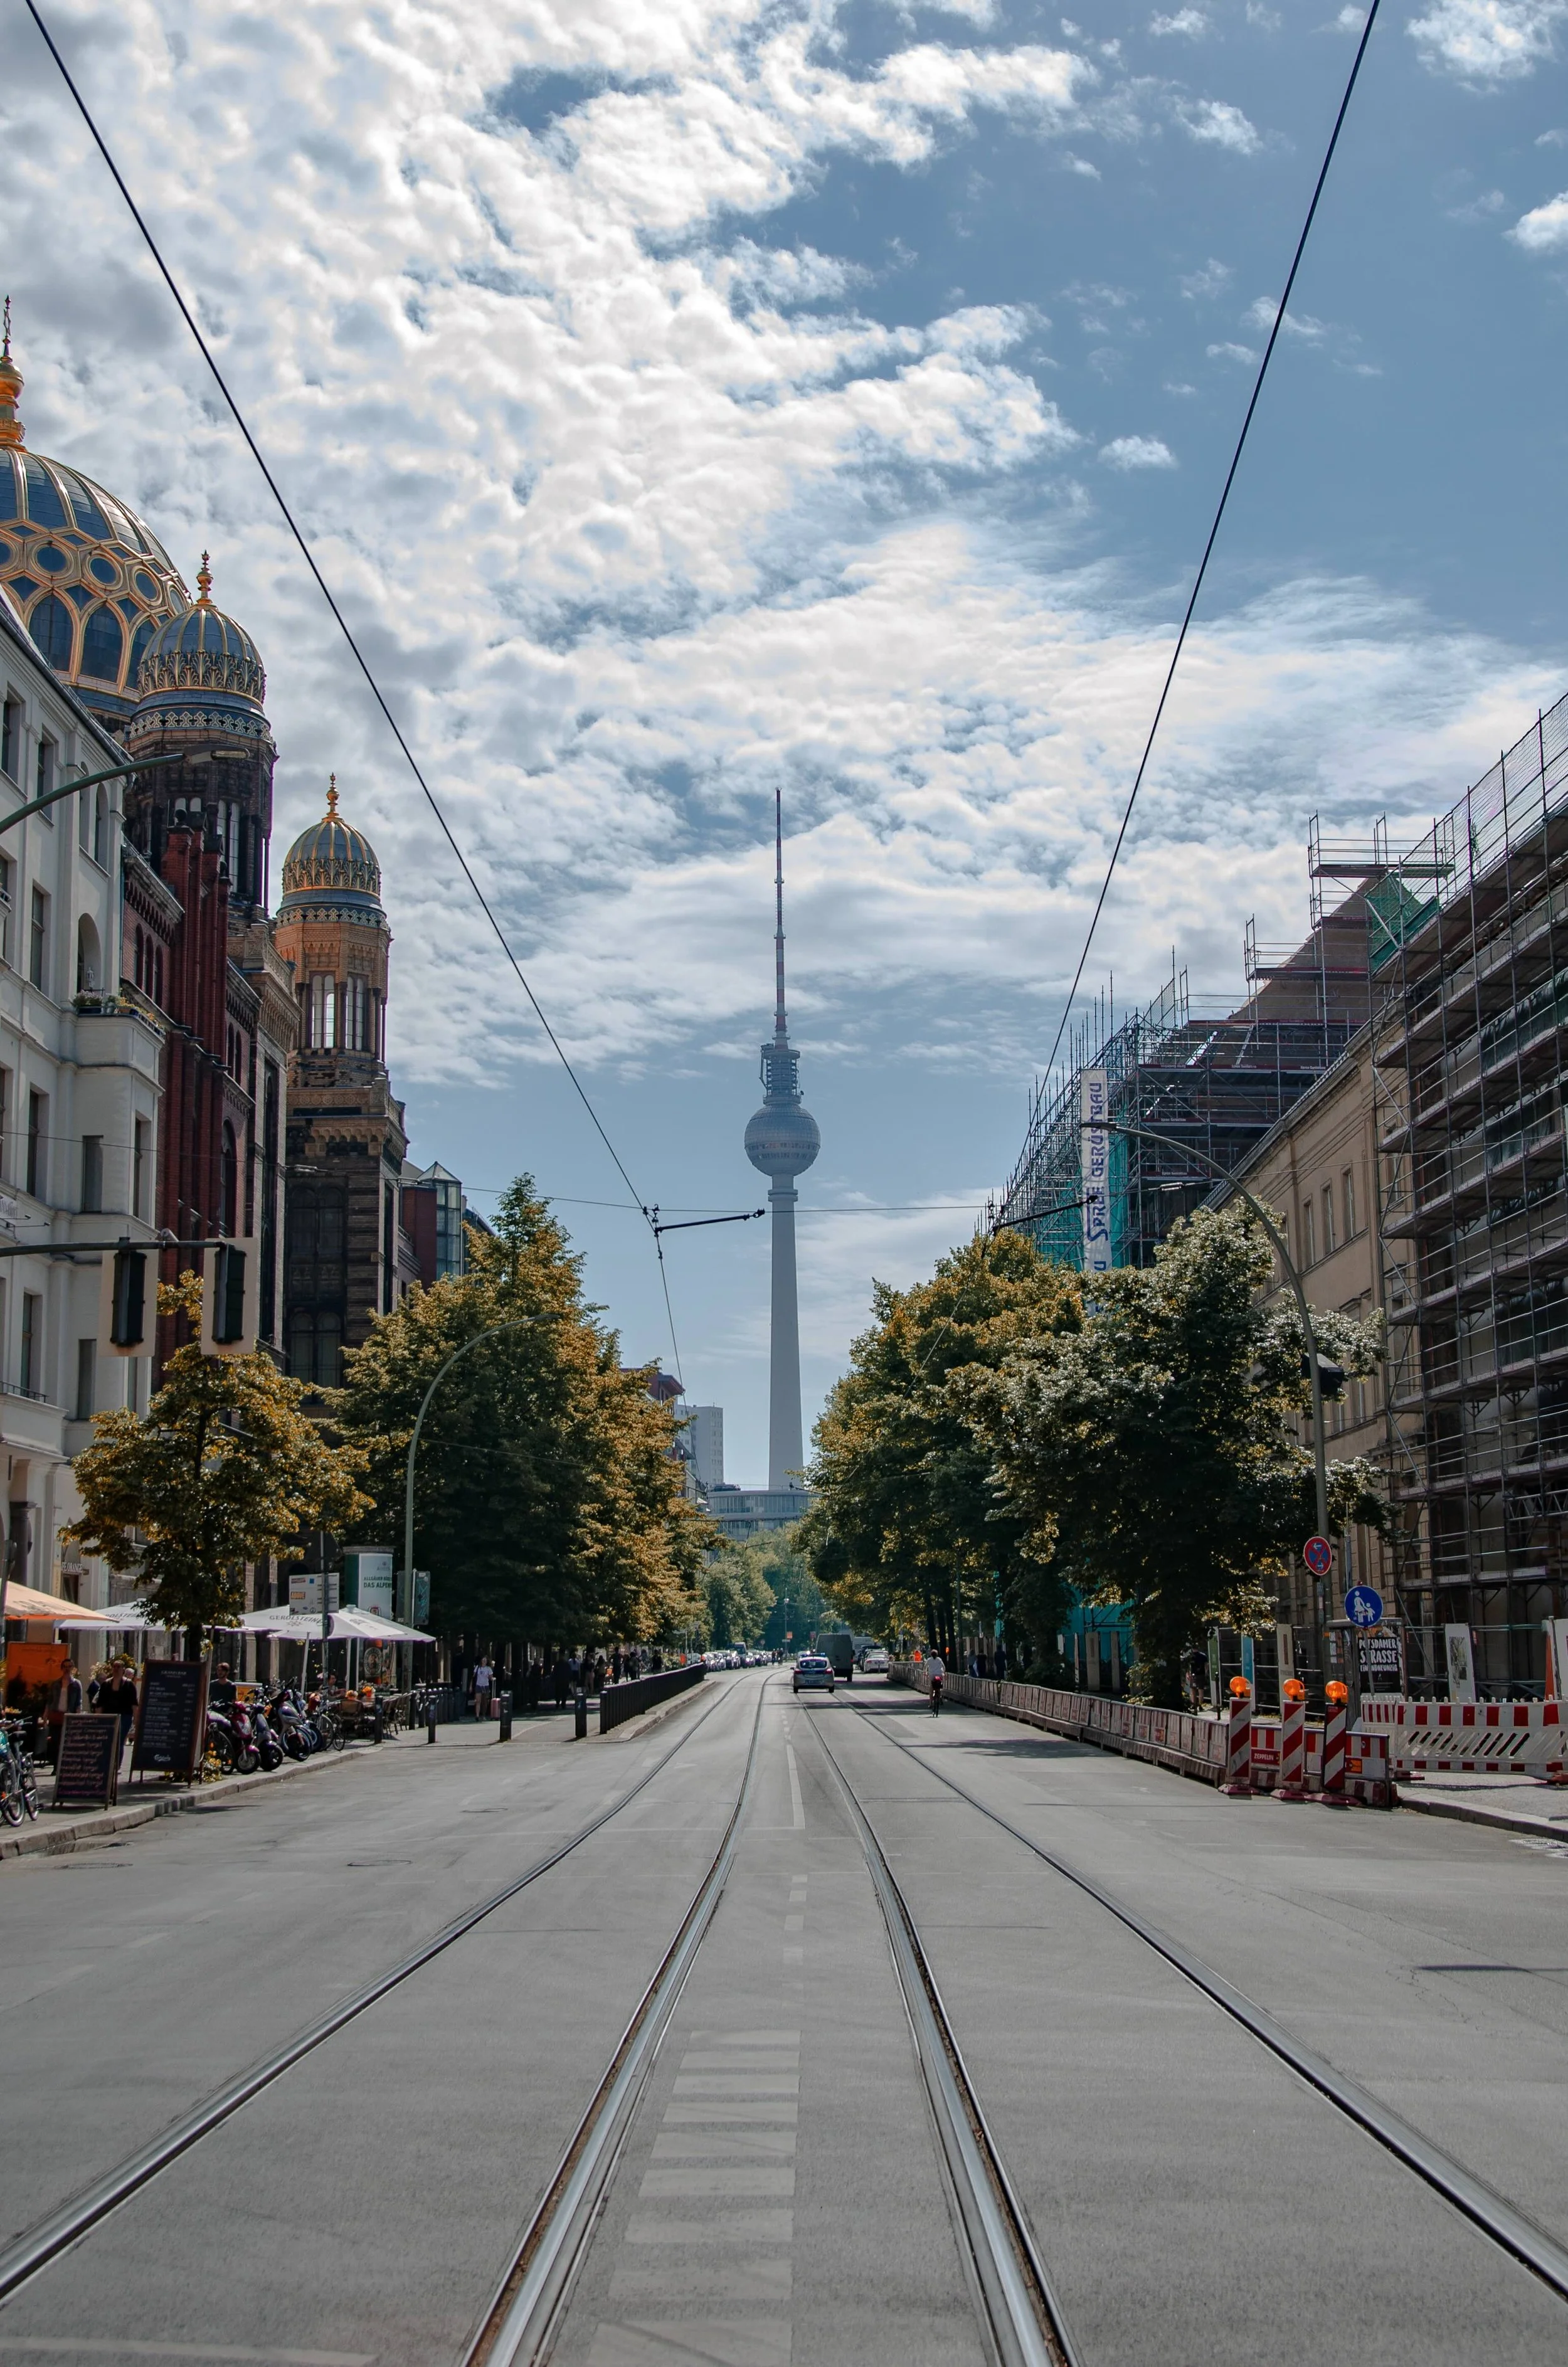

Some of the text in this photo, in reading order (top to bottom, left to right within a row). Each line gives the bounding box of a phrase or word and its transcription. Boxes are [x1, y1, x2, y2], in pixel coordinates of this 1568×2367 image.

[269, 1614, 324, 1624] GEROLSTEINE
[1360, 1649, 1397, 1663] SRASSE
[1254, 1753, 1274, 1761] ZEPPELIN
